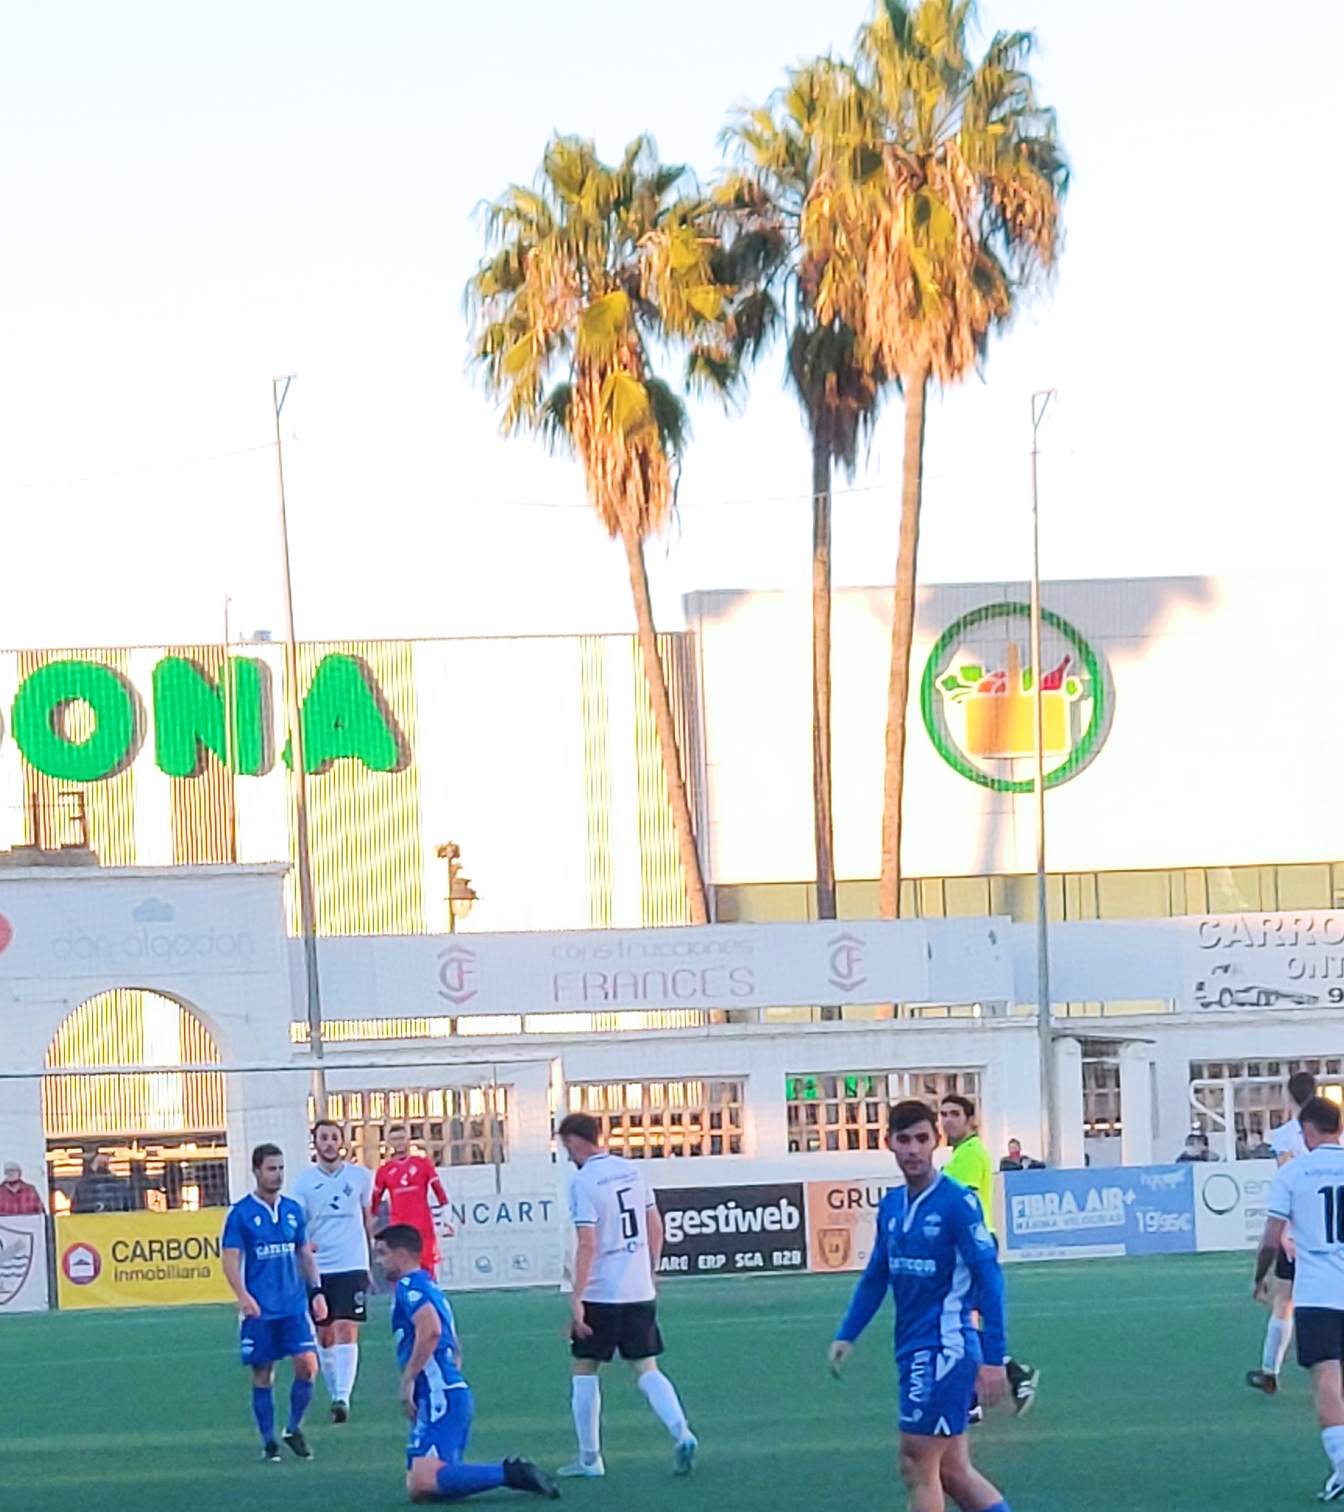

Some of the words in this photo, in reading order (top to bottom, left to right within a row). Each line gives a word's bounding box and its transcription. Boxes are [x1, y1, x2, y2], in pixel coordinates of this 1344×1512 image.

[616, 1187, 639, 1240] 5
[664, 1198, 800, 1241] gestiweb
[698, 1254, 726, 1269] ERP
